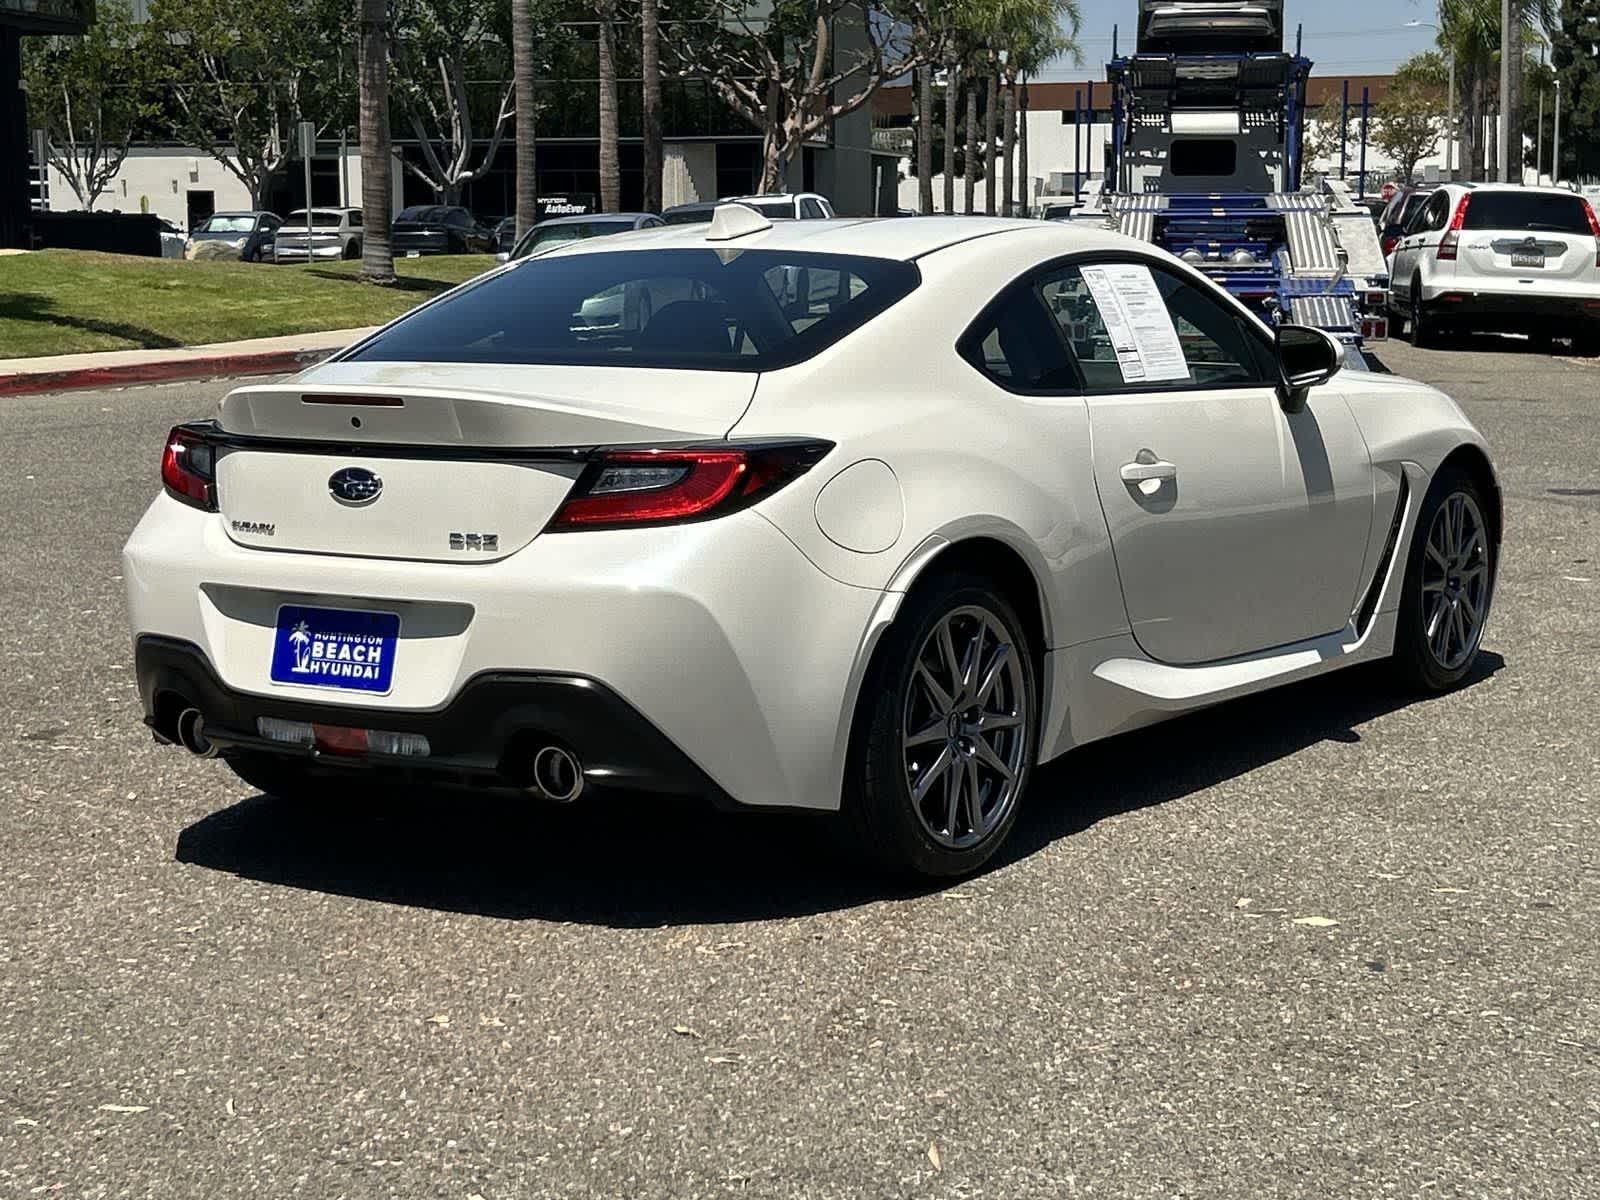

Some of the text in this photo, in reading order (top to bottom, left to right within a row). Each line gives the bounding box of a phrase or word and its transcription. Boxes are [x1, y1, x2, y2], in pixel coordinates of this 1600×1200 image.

[544, 204, 587, 213] AutoEver
[231, 520, 276, 533] SUBARU
[449, 532, 498, 551] BRZ
[314, 631, 383, 645] HUNTINGTON
[312, 641, 381, 663] BEACH
[310, 661, 380, 679] HYUNDAI
